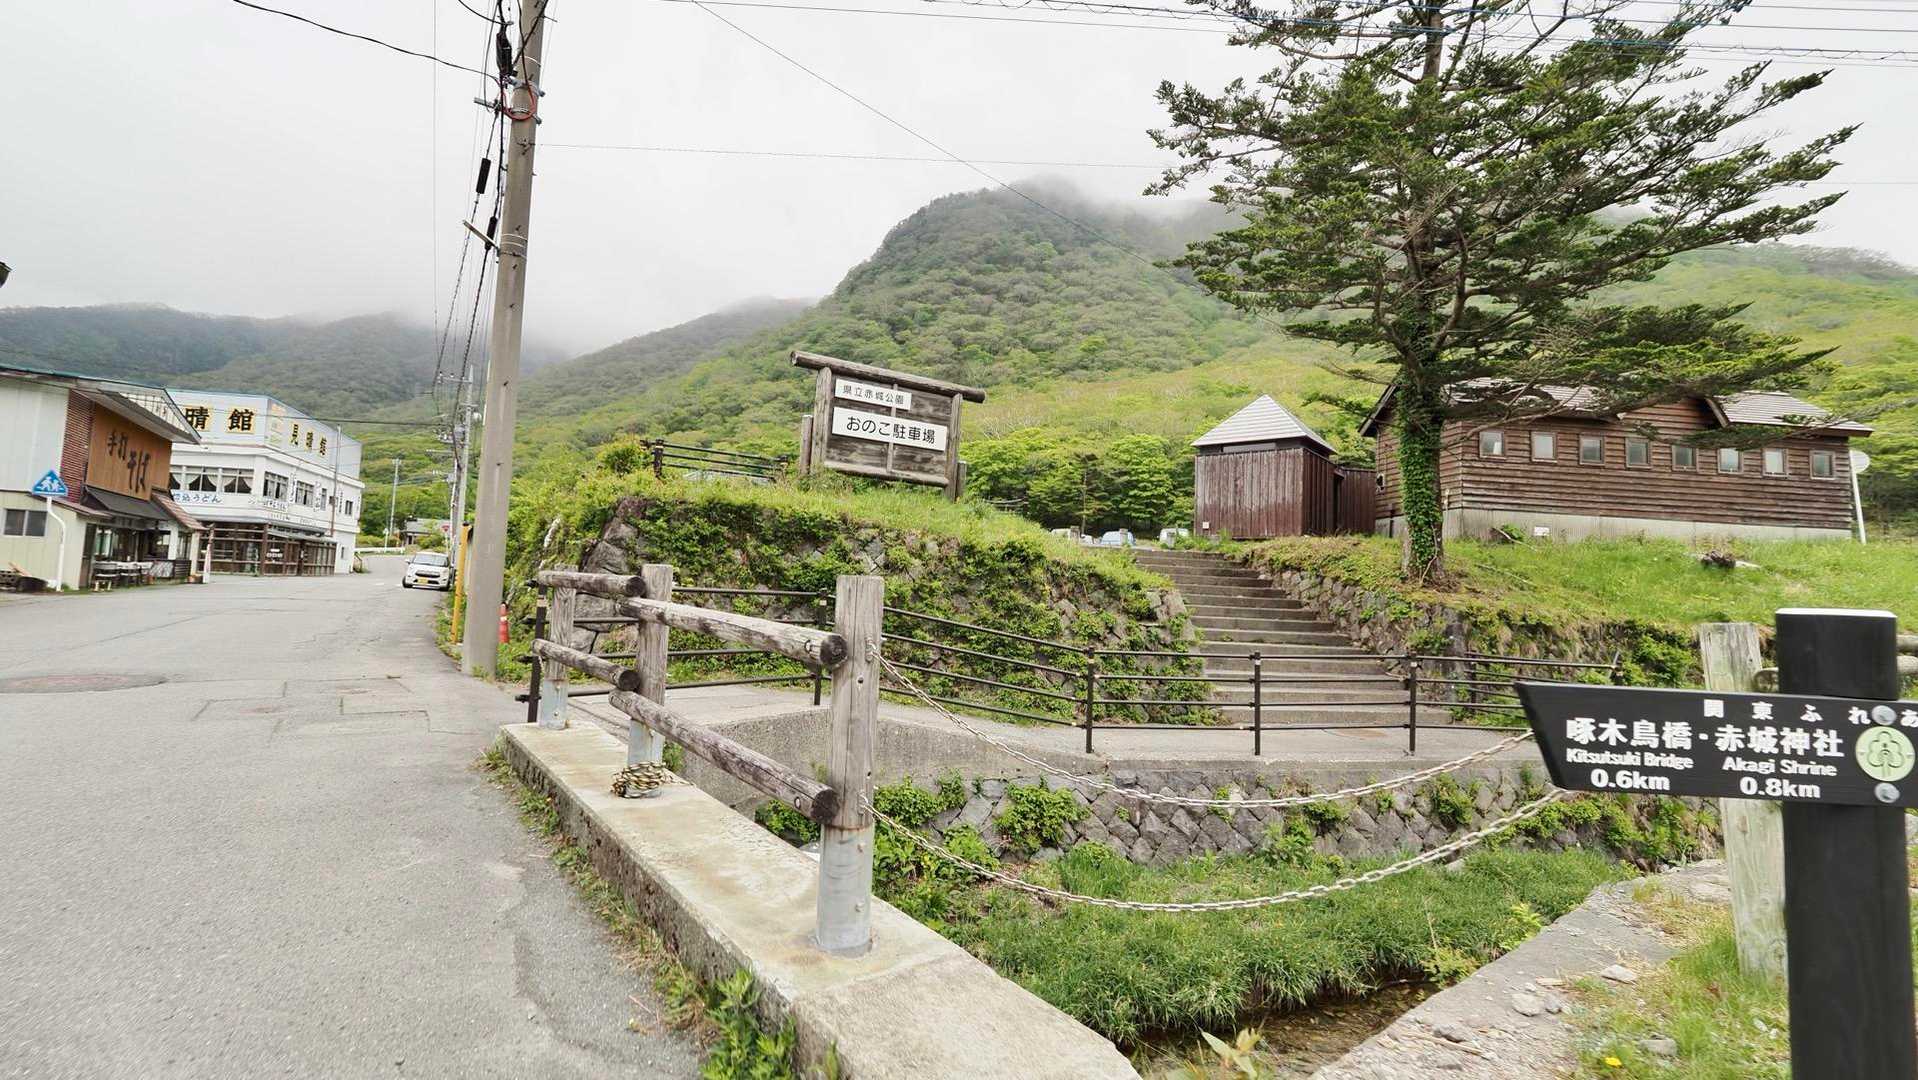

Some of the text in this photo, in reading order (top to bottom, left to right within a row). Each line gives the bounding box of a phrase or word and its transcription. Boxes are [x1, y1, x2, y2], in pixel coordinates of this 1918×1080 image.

[843, 384, 904, 405] 県立赤城公園
[846, 415, 936, 444] おのこ駐車場
[1566, 747, 1694, 771] Kitsutsuki Bridge
[1722, 756, 1838, 777] Akagi Shrine
[1590, 768, 1671, 791] 0.6km
[1739, 776, 1821, 798] 0.8km
